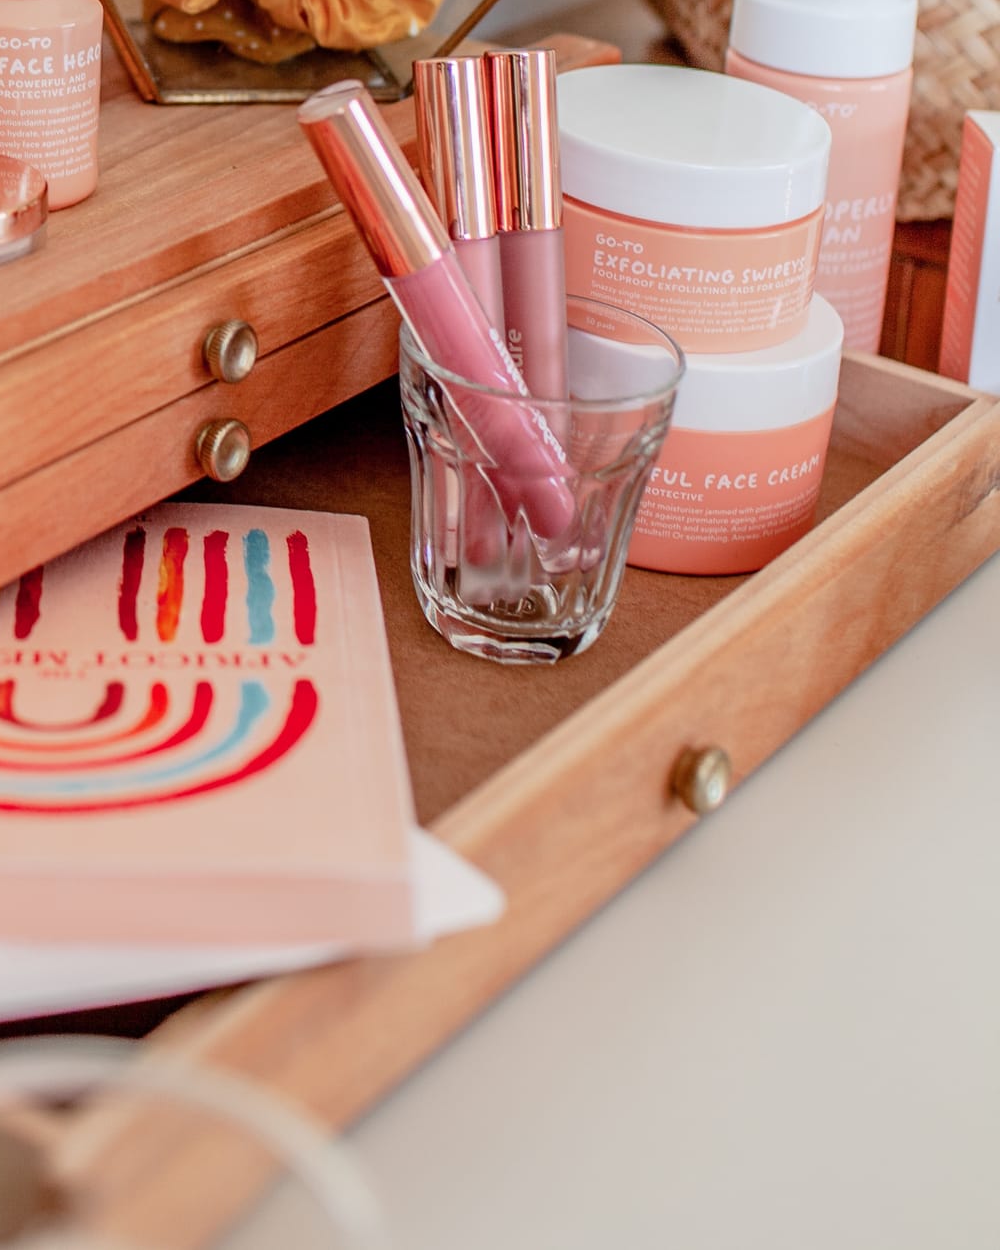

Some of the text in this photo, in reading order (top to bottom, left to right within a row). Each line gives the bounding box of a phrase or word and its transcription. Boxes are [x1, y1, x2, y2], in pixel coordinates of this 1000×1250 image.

[63, 42, 101, 73] HERO
[8, 77, 66, 89] POWERFUL
[69, 71, 87, 85] AND
[66, 81, 87, 95] FACE
[596, 232, 645, 254] GO-TO
[593, 250, 736, 285] EXFOLIATING
[742, 256, 807, 285] SWIPEYS
[592, 267, 655, 288] FOOLPROOF
[657, 283, 728, 295] EXFOLIATING
[730, 284, 755, 295] PADS
[756, 282, 774, 293] FOR
[508, 328, 524, 375] ure
[650, 453, 820, 490] FUL FACE CREAM
[644, 485, 704, 502] ROTECTIVE
[93, 650, 308, 670] APRICOT
